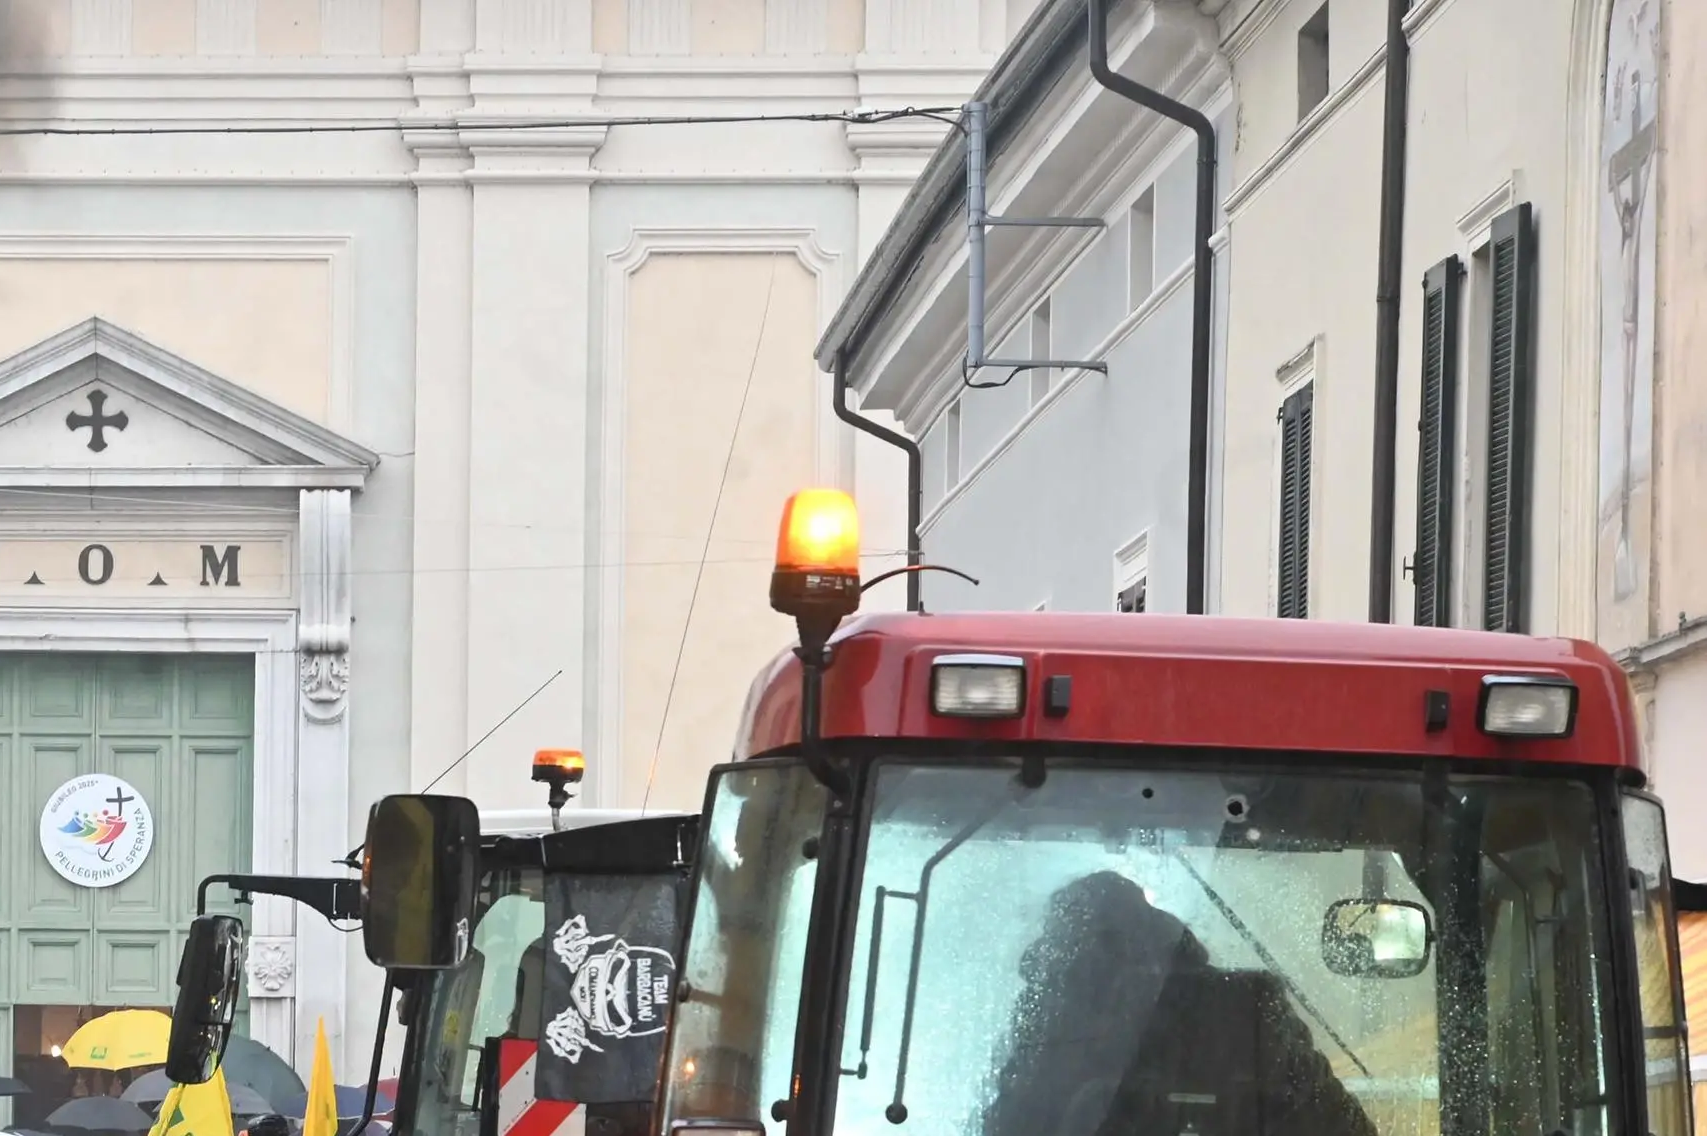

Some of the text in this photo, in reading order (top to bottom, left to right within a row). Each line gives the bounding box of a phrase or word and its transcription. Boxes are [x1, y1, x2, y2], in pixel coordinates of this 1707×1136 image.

[78, 543, 114, 585] O
[200, 545, 241, 586] M
[55, 807, 146, 881] PELLEGRINI DI SPERANZA
[653, 974, 669, 1004] TEAM
